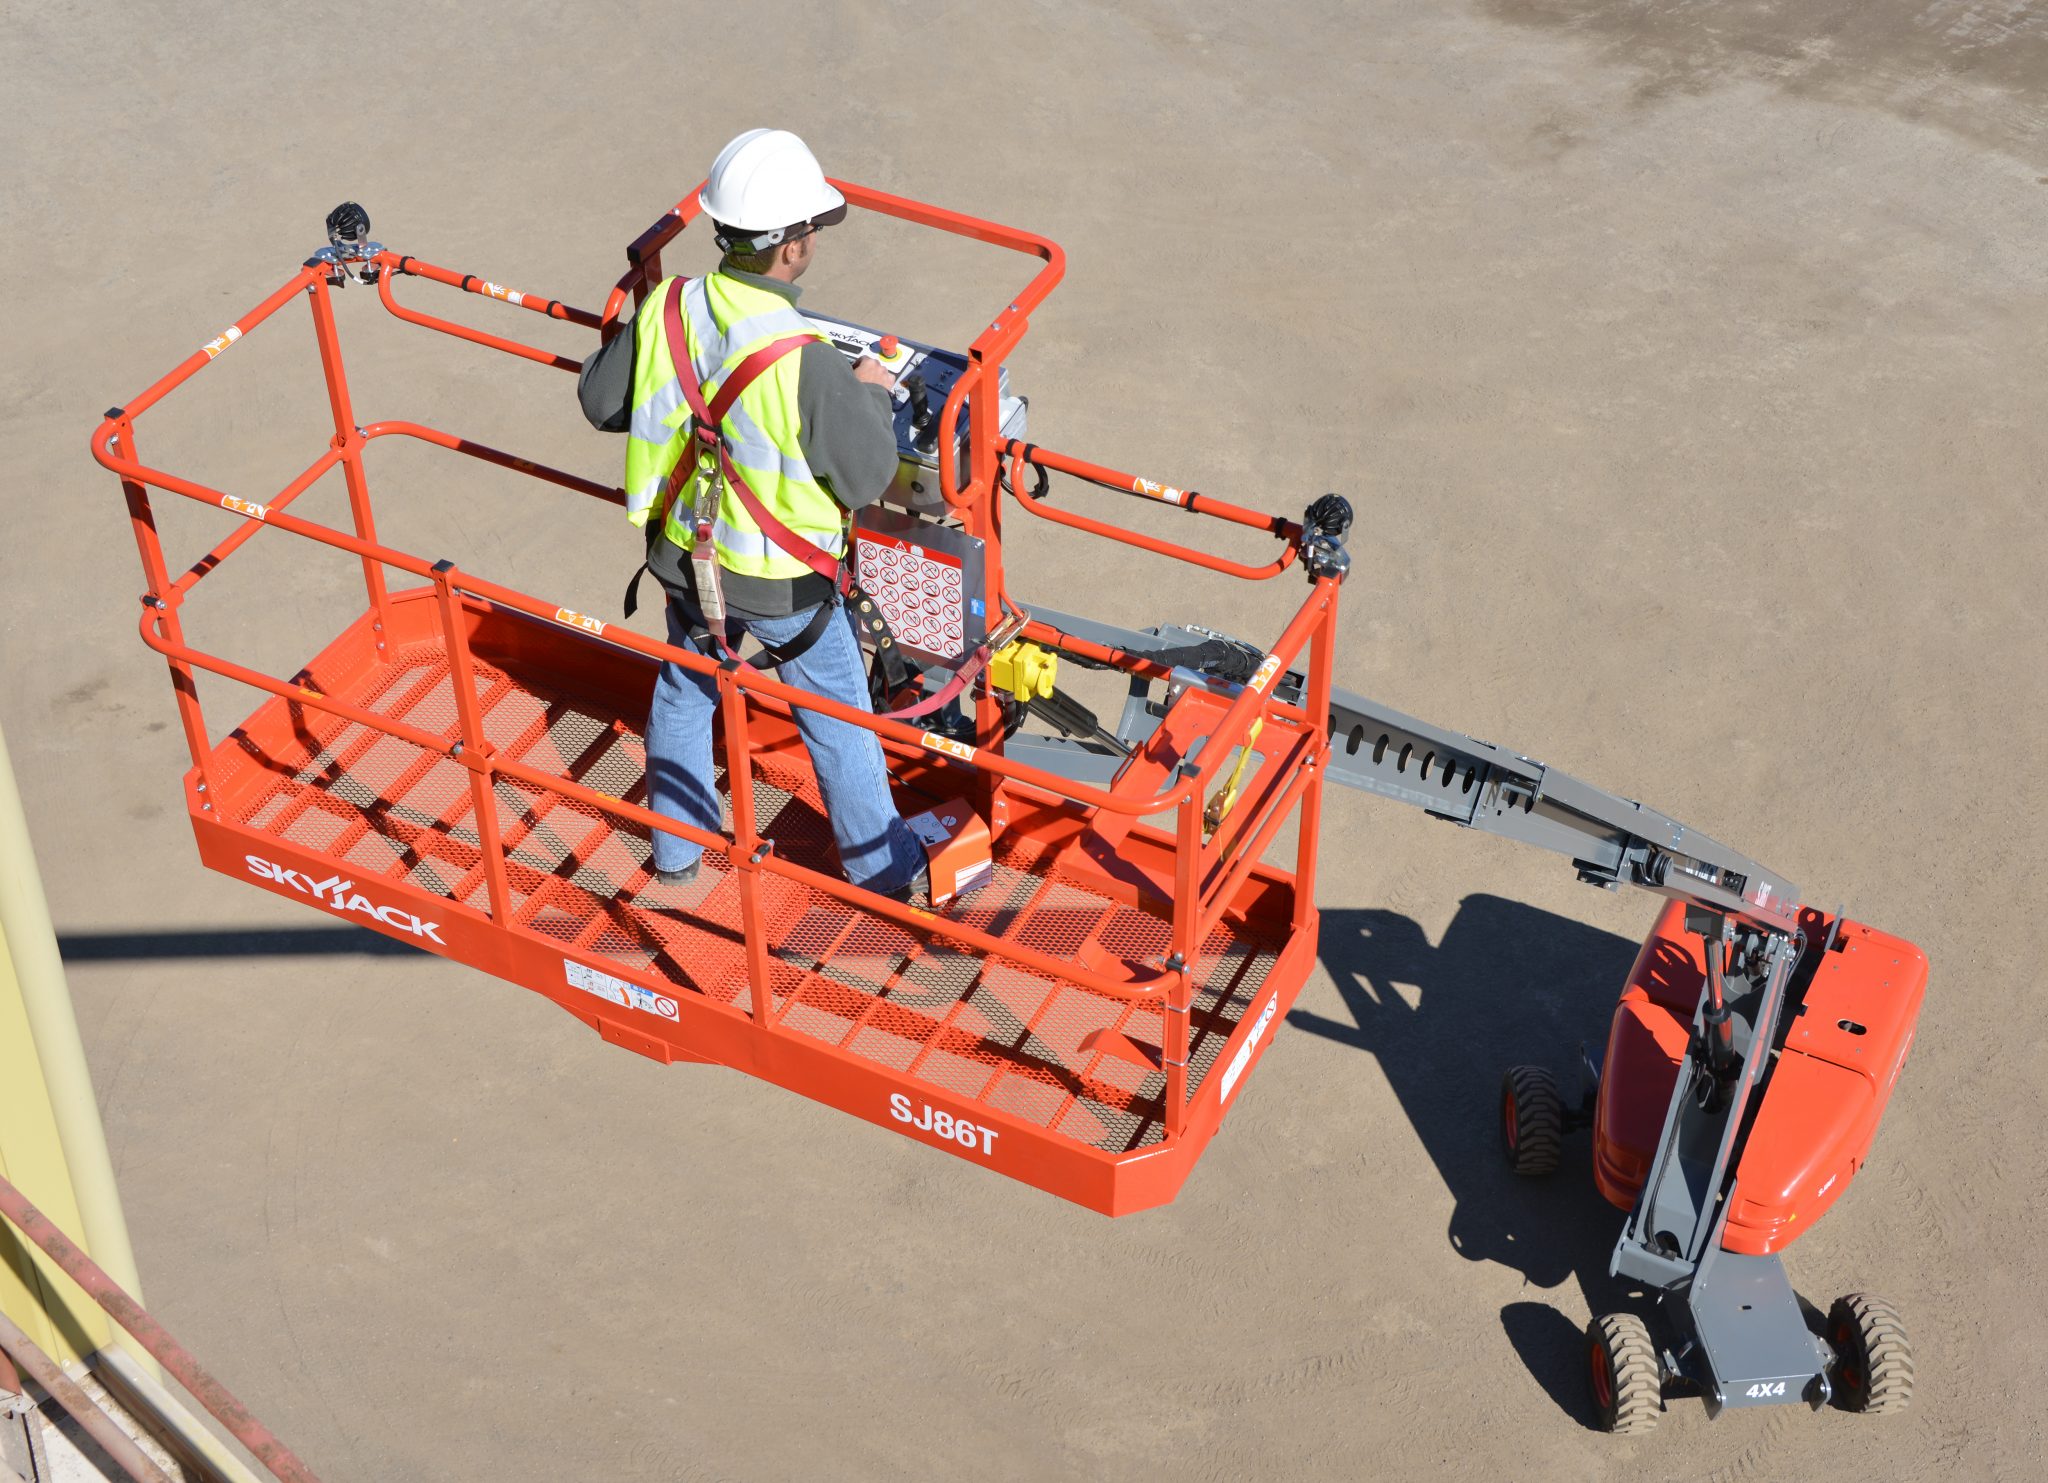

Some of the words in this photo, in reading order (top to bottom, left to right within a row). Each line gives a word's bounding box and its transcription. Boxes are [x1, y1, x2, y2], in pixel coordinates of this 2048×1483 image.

[245, 855, 447, 945] SKYJACK
[890, 1093, 999, 1156] SJ86T
[1746, 1382, 1786, 1398] 4X4
